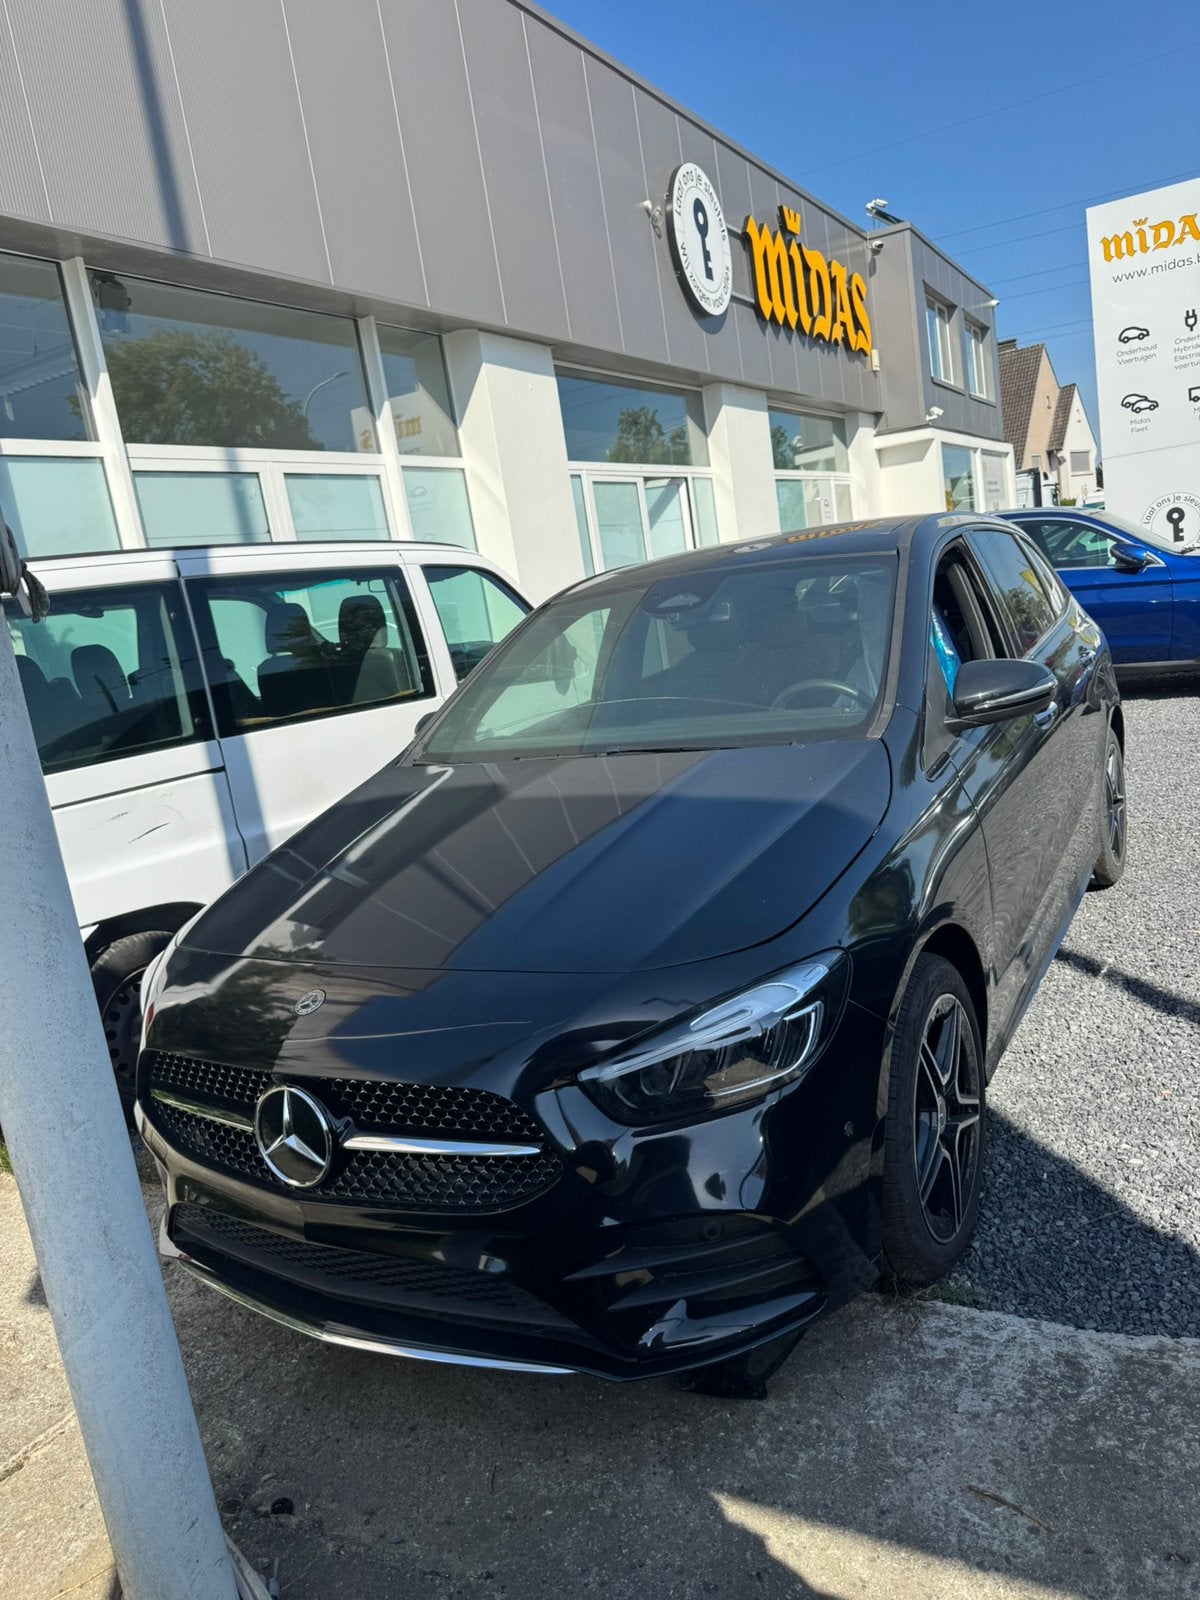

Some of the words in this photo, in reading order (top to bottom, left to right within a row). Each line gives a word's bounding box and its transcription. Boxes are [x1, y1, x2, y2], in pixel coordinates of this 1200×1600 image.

[1116, 344, 1157, 357] Onderhoud
[1117, 353, 1157, 365] Voertuigen
[1156, 497, 1171, 508] ons
[1173, 494, 1181, 503] je
